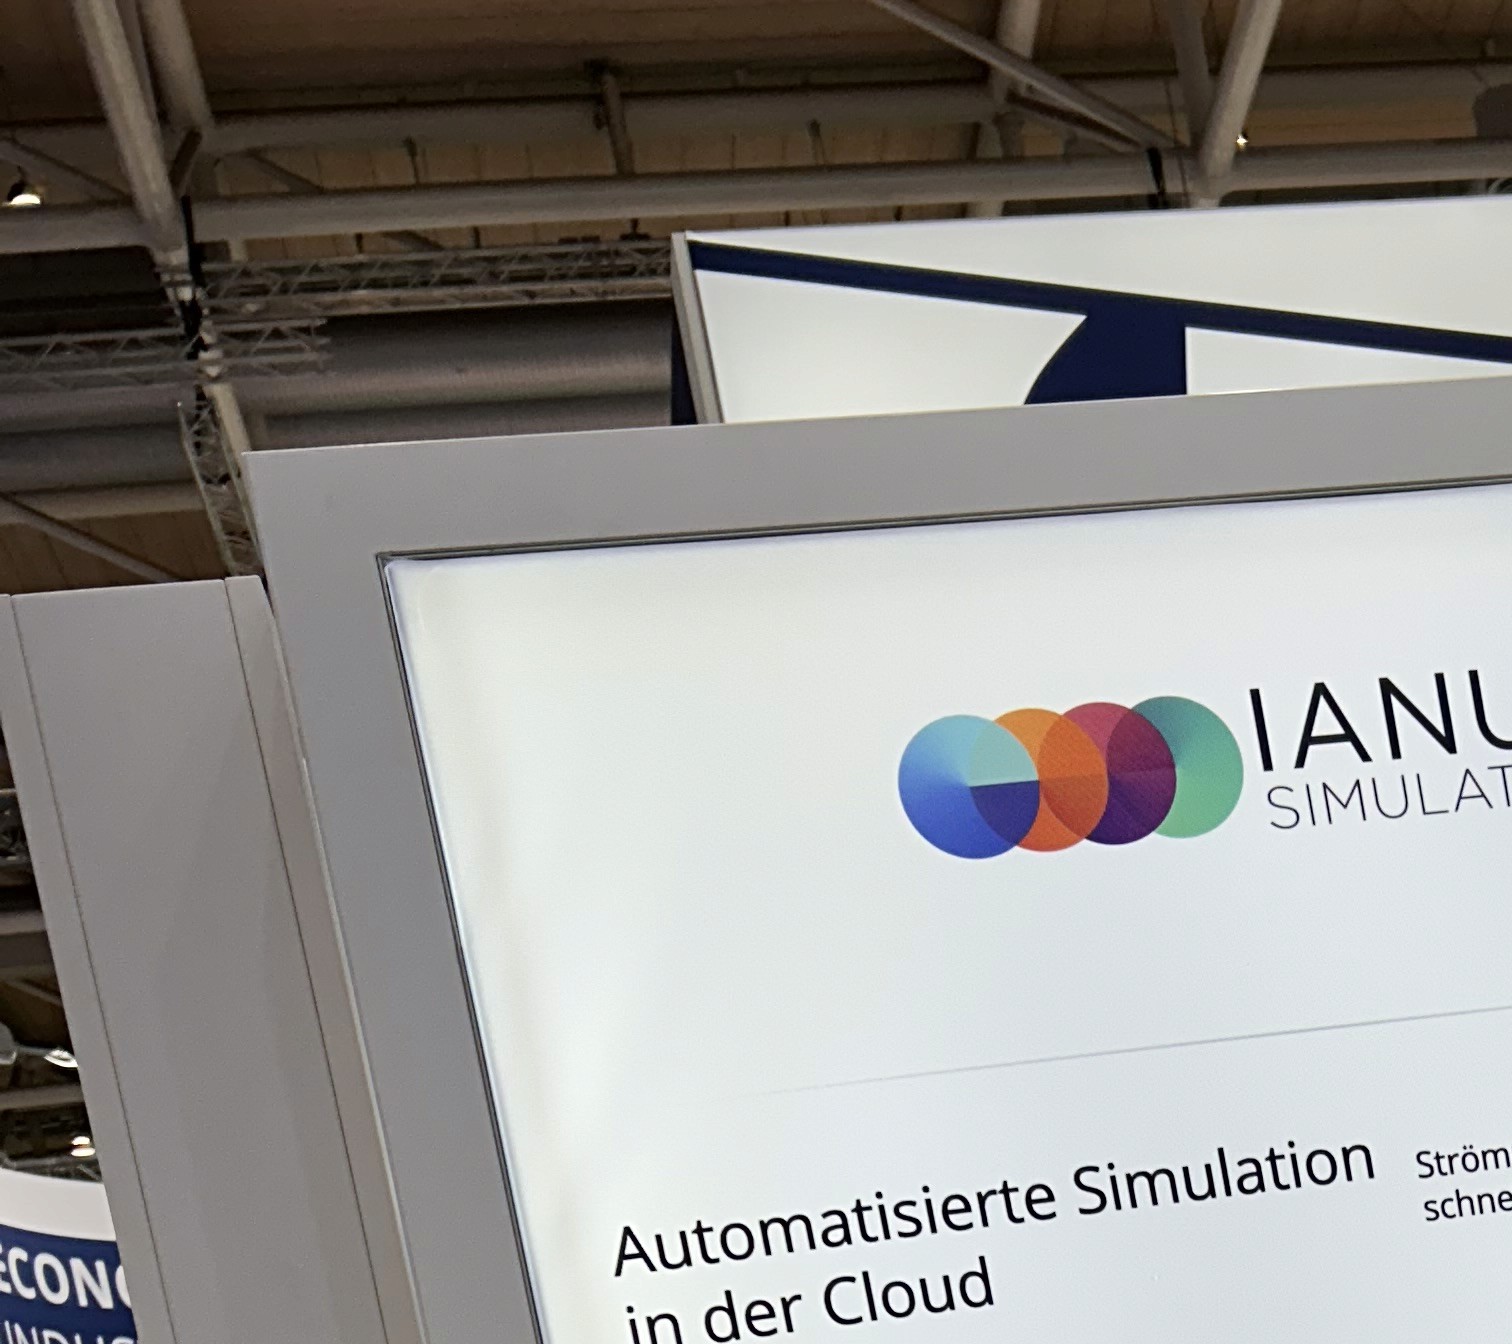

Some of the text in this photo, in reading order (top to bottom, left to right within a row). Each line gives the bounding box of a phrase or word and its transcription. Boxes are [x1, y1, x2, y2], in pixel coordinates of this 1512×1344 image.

[615, 1141, 1374, 1276] Automatisierte Simulation
[705, 1290, 801, 1342] der
[824, 1256, 993, 1325] Cloud
